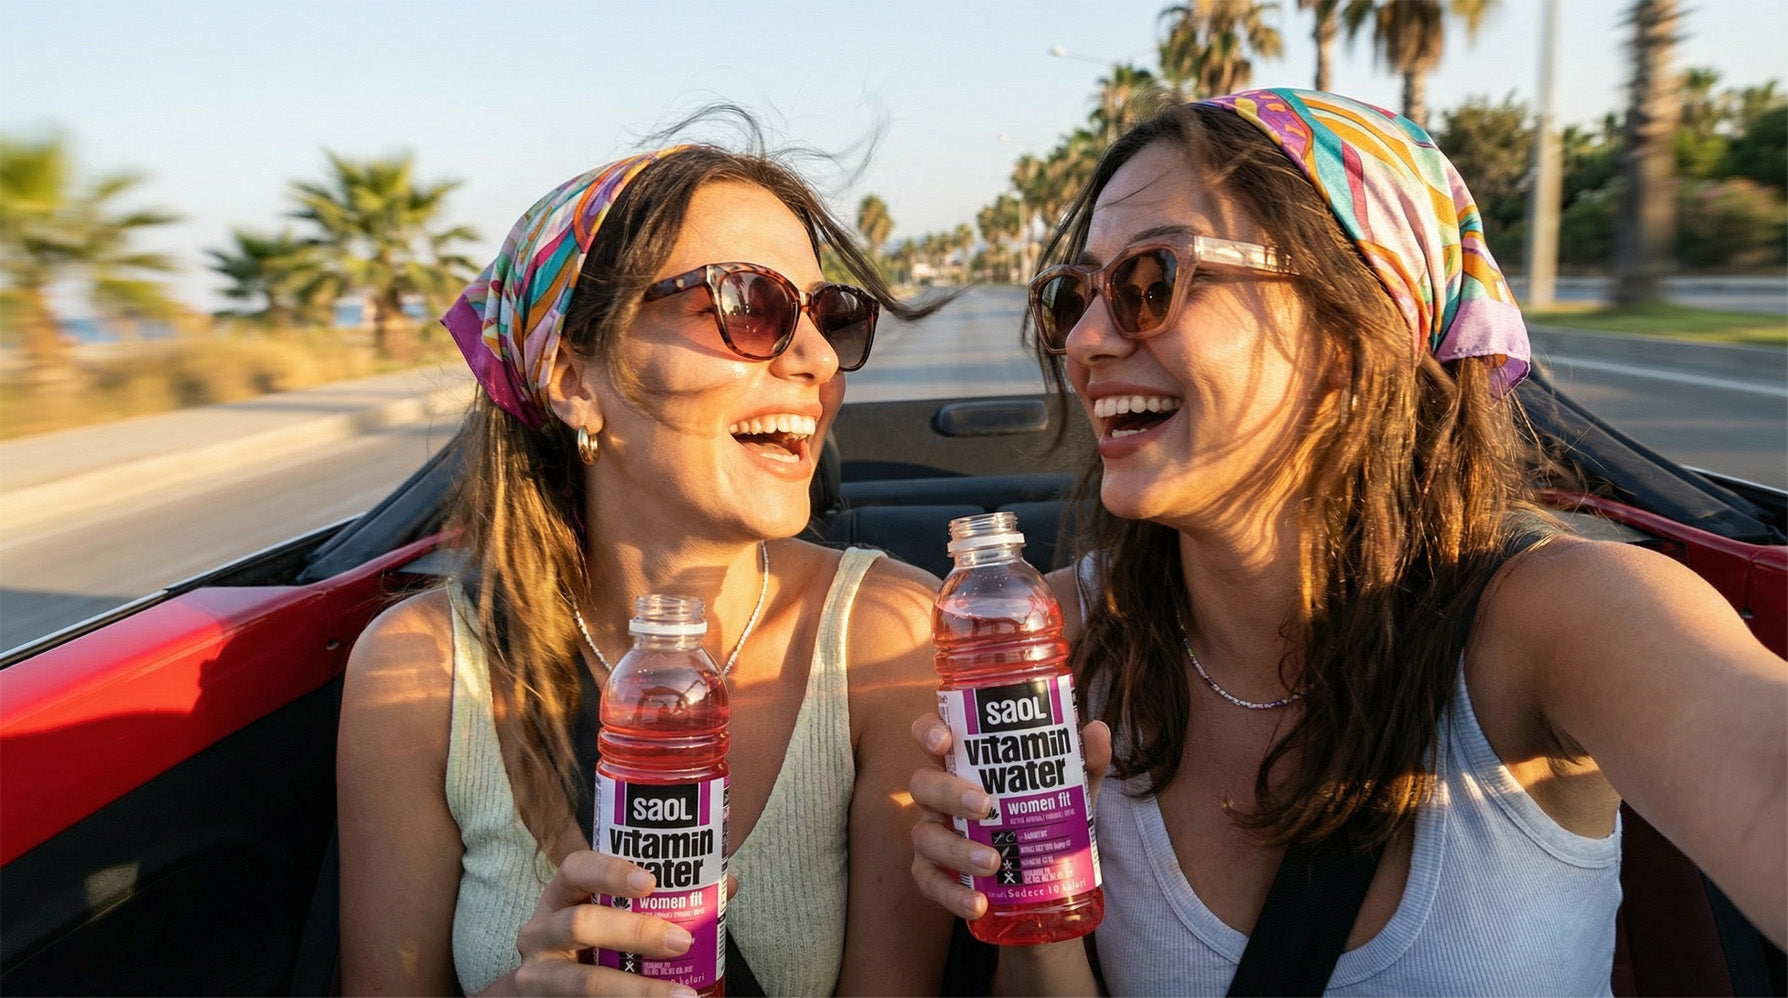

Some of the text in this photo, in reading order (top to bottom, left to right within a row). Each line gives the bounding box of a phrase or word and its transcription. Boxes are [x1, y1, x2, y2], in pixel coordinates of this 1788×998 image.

[964, 727, 1071, 766] vitamin
[978, 757, 1066, 795] water
[1008, 791, 1071, 815] women fit
[609, 828, 713, 859] vitamin
[628, 859, 704, 888] ater
[640, 890, 703, 910] women fit
[1007, 887, 1045, 898] Sadece
[1047, 886, 1059, 894] 10
